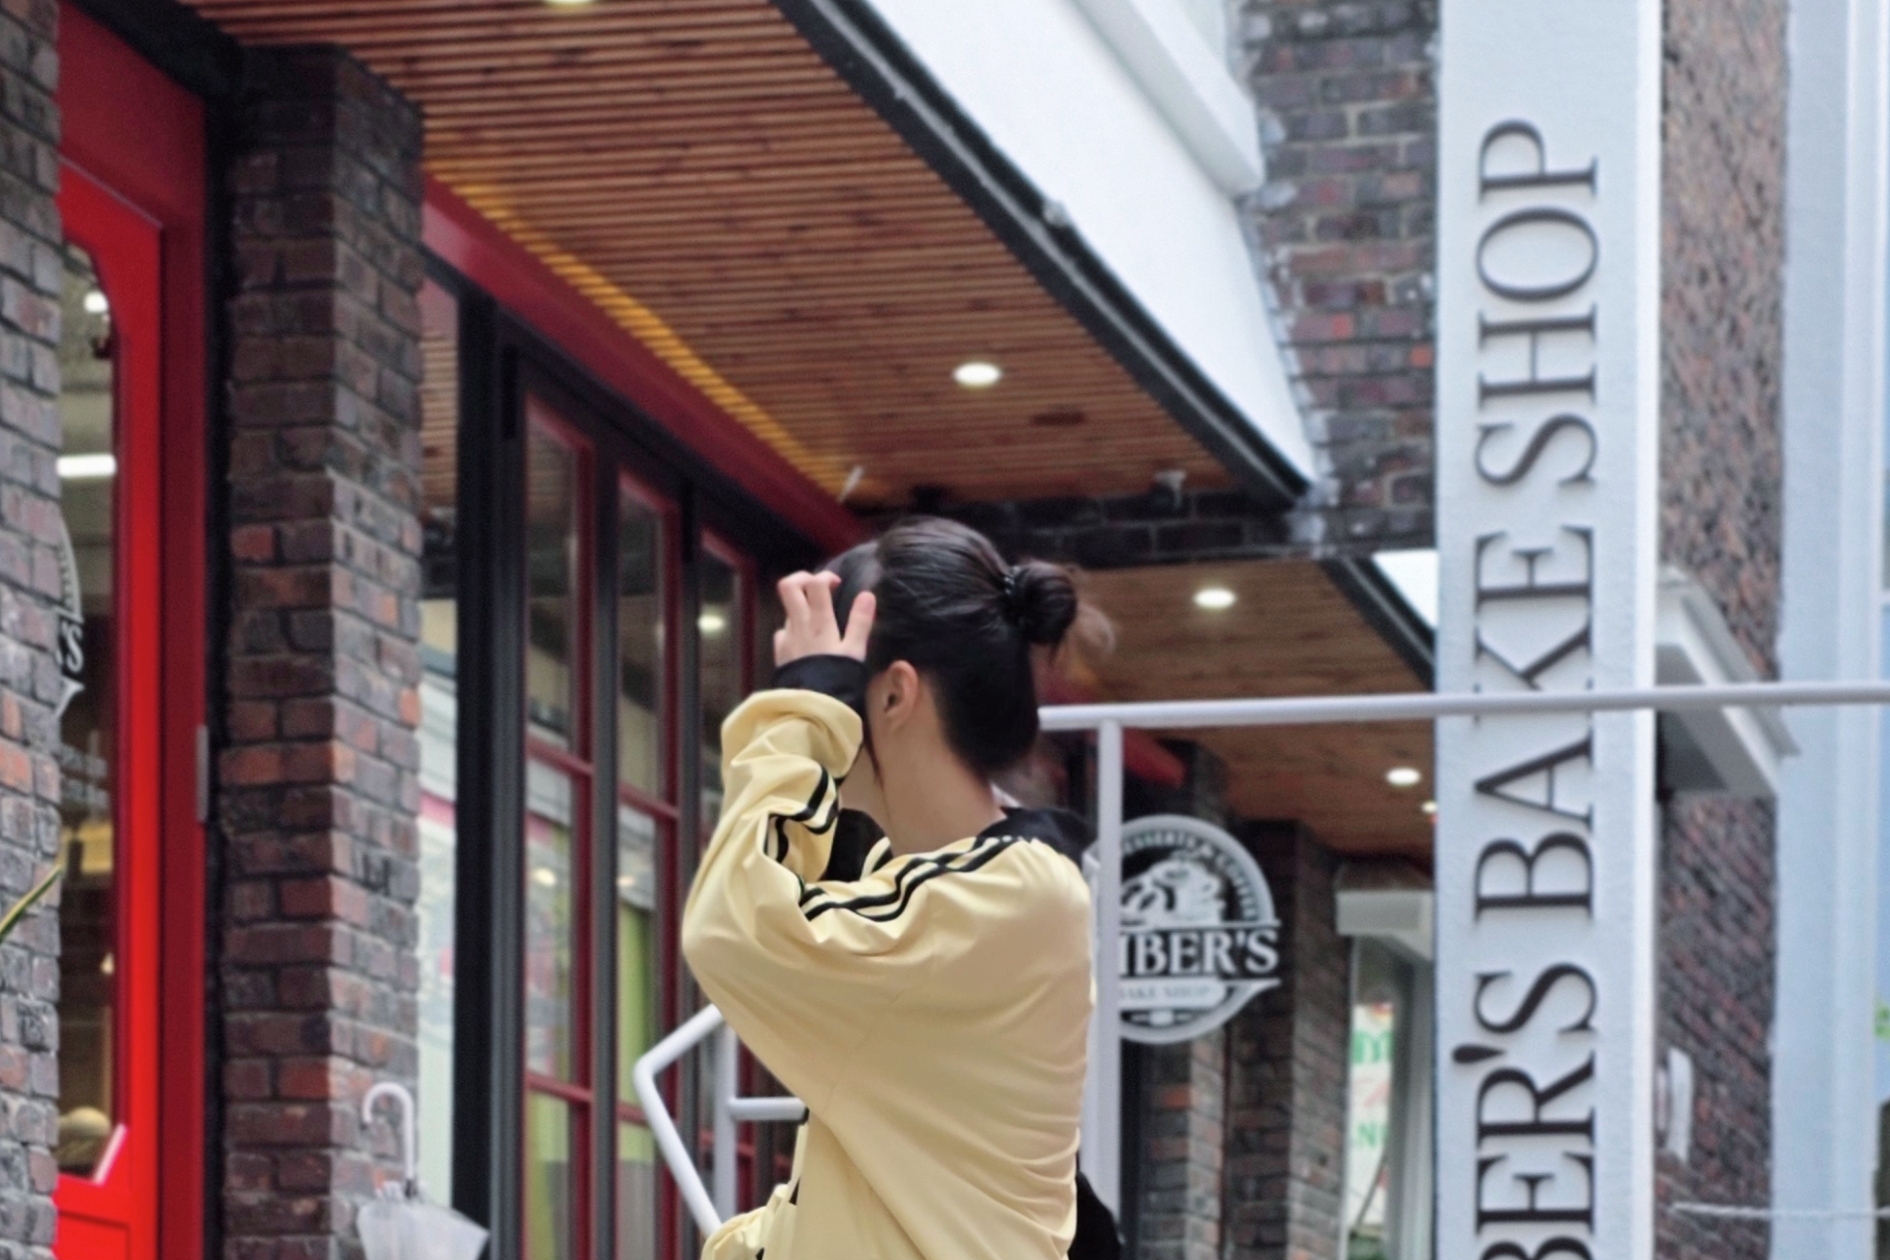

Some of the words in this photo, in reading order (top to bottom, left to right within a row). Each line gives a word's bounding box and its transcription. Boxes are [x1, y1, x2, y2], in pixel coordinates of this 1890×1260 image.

[1473, 119, 1600, 486] SHOP
[1473, 525, 1596, 921] BAKE
[1118, 929, 1280, 976] BER'S
